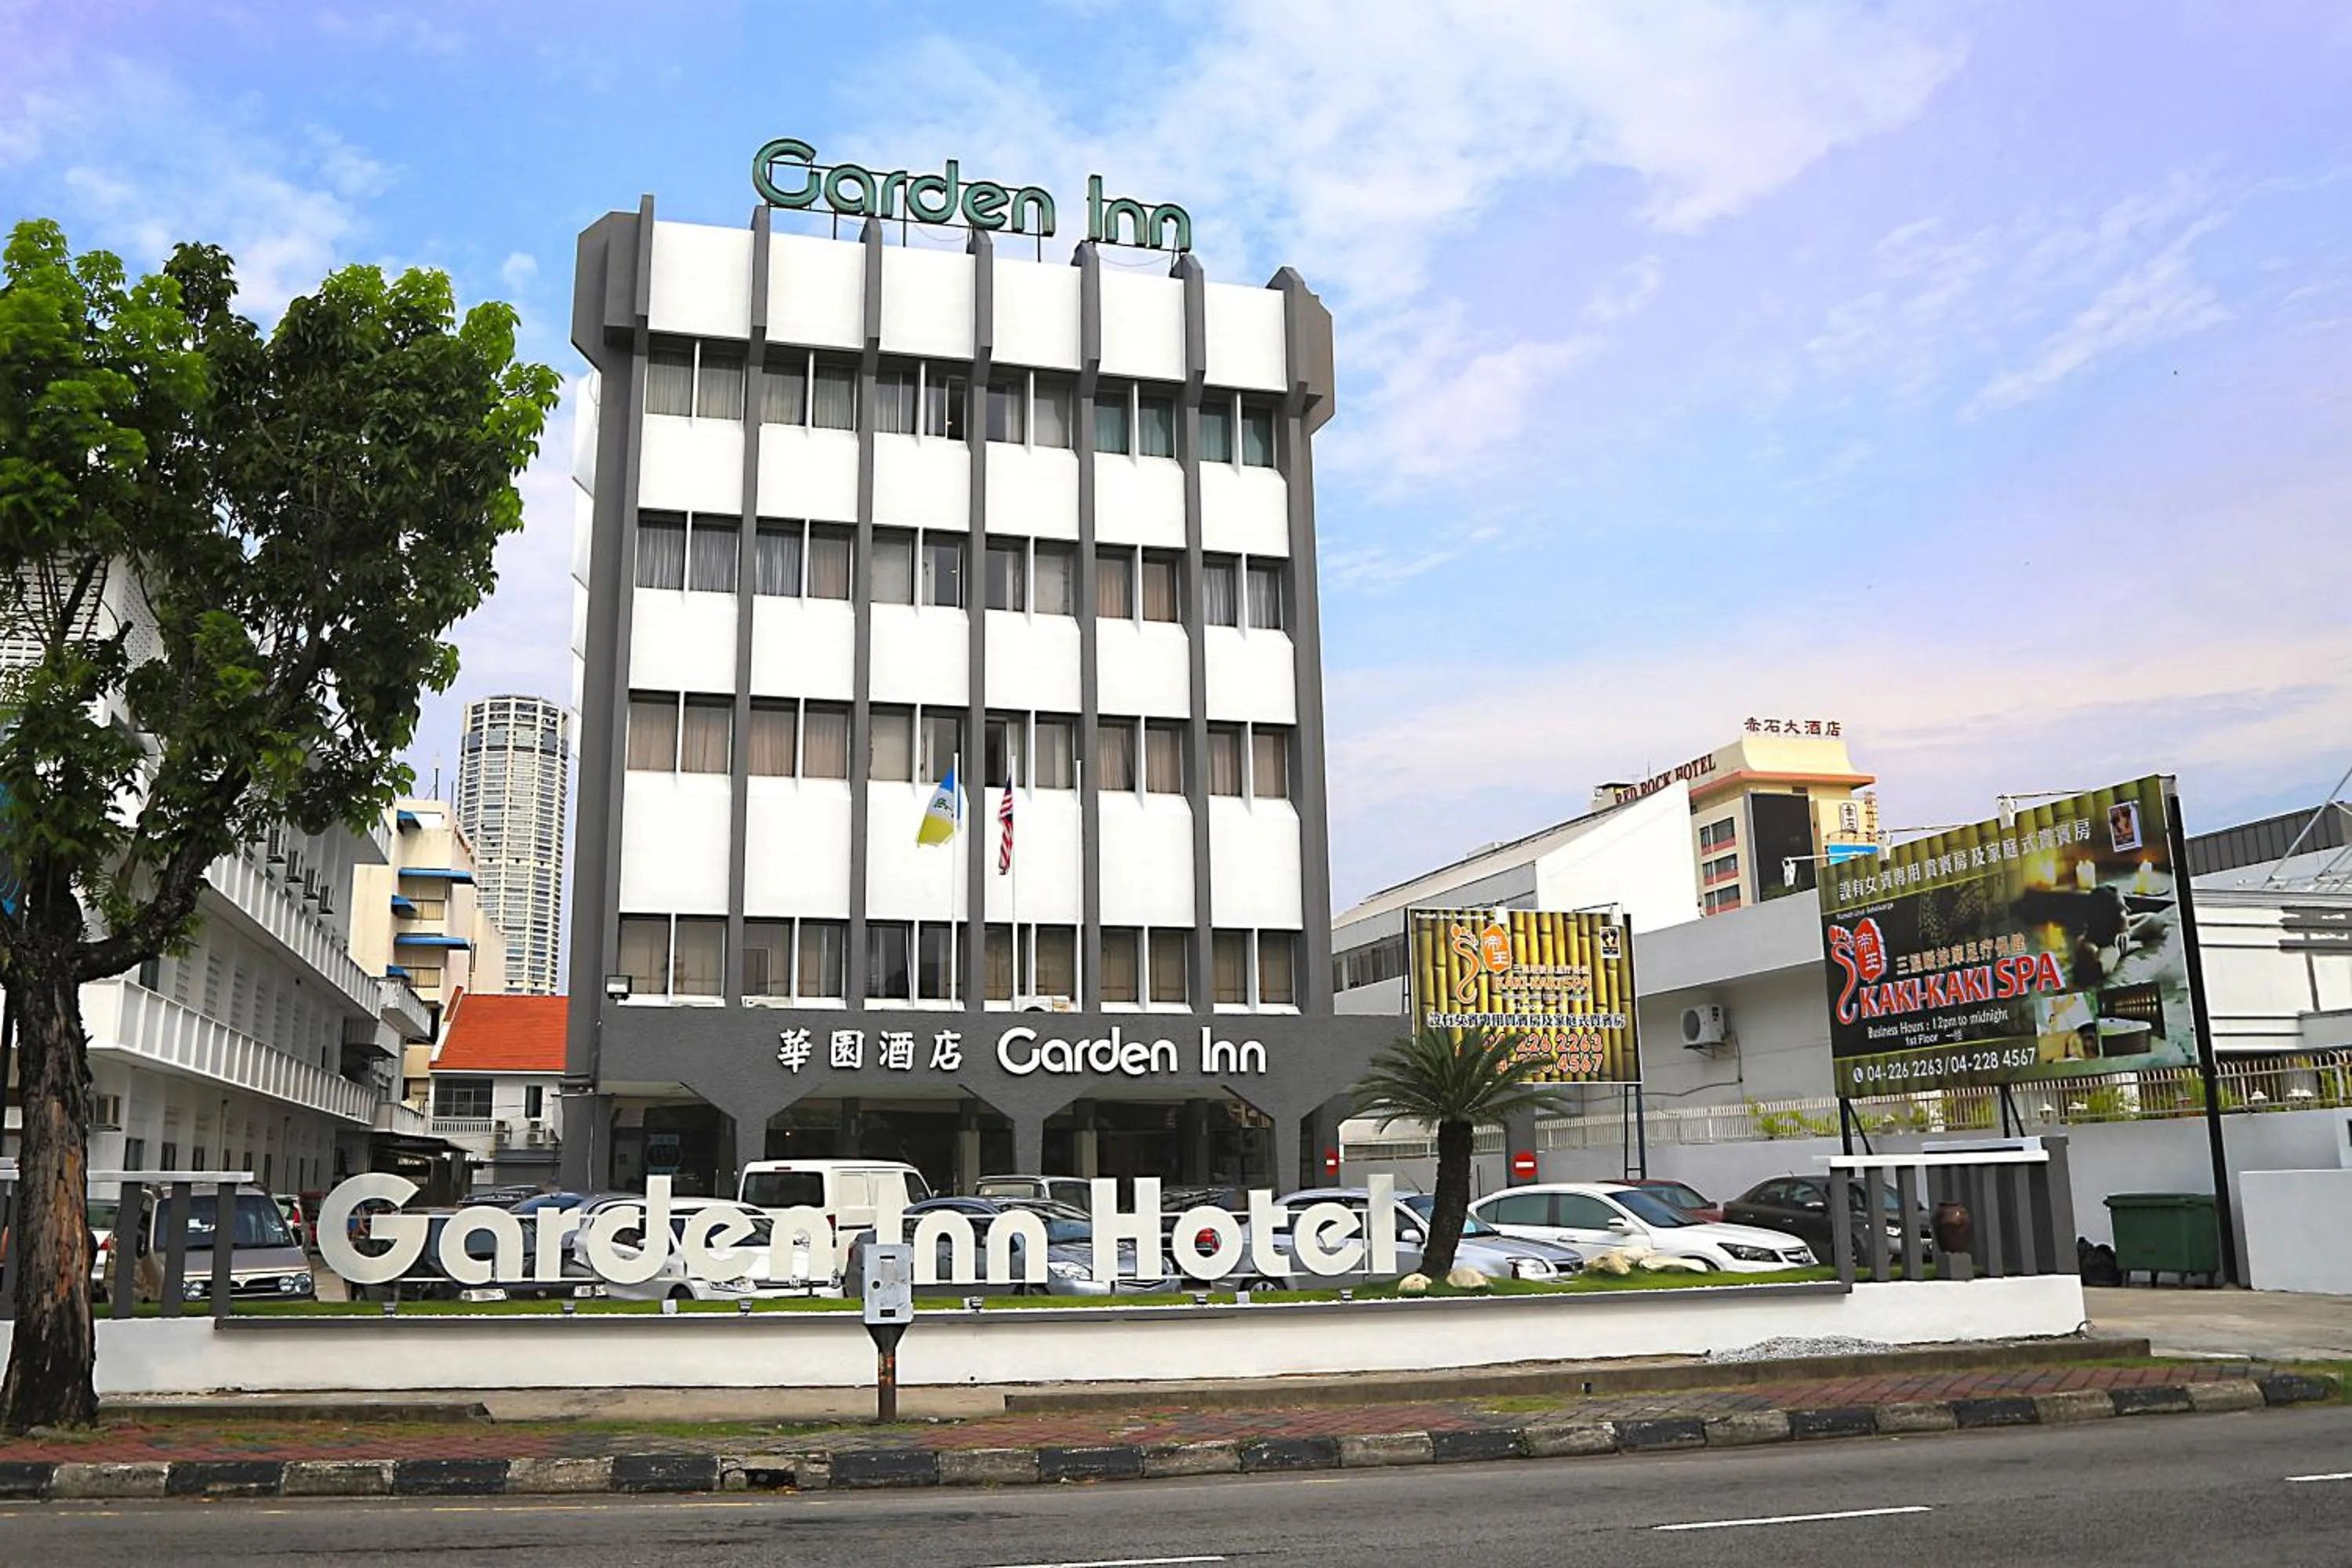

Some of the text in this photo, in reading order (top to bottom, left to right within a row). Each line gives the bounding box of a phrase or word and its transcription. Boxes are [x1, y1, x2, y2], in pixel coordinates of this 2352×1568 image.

[753, 138, 1192, 252] Garden Inn
[1743, 717, 1842, 736] 赤石大酒店
[1615, 753, 1716, 804] RED ROCK HOTEL
[1859, 951, 2066, 1018] KAKI-KAKI SPA
[1556, 1033, 1603, 1053] 2263
[1867, 1024, 1898, 1040] Business
[1900, 1021, 1924, 1035] Hours
[1958, 1016, 1968, 1025] to
[1969, 1007, 2009, 1025] midnight
[1905, 1036, 1917, 1046] 1st
[1918, 1033, 1938, 1044] Floor
[777, 1028, 964, 1073] 華園酒店
[997, 1026, 1267, 1076] Garden Inn
[1557, 1053, 1604, 1073] 4567
[1867, 1062, 1909, 1081] 04-226
[2002, 1047, 2036, 1067] 4567
[318, 1173, 1398, 1285] Garden Inn Hotel
